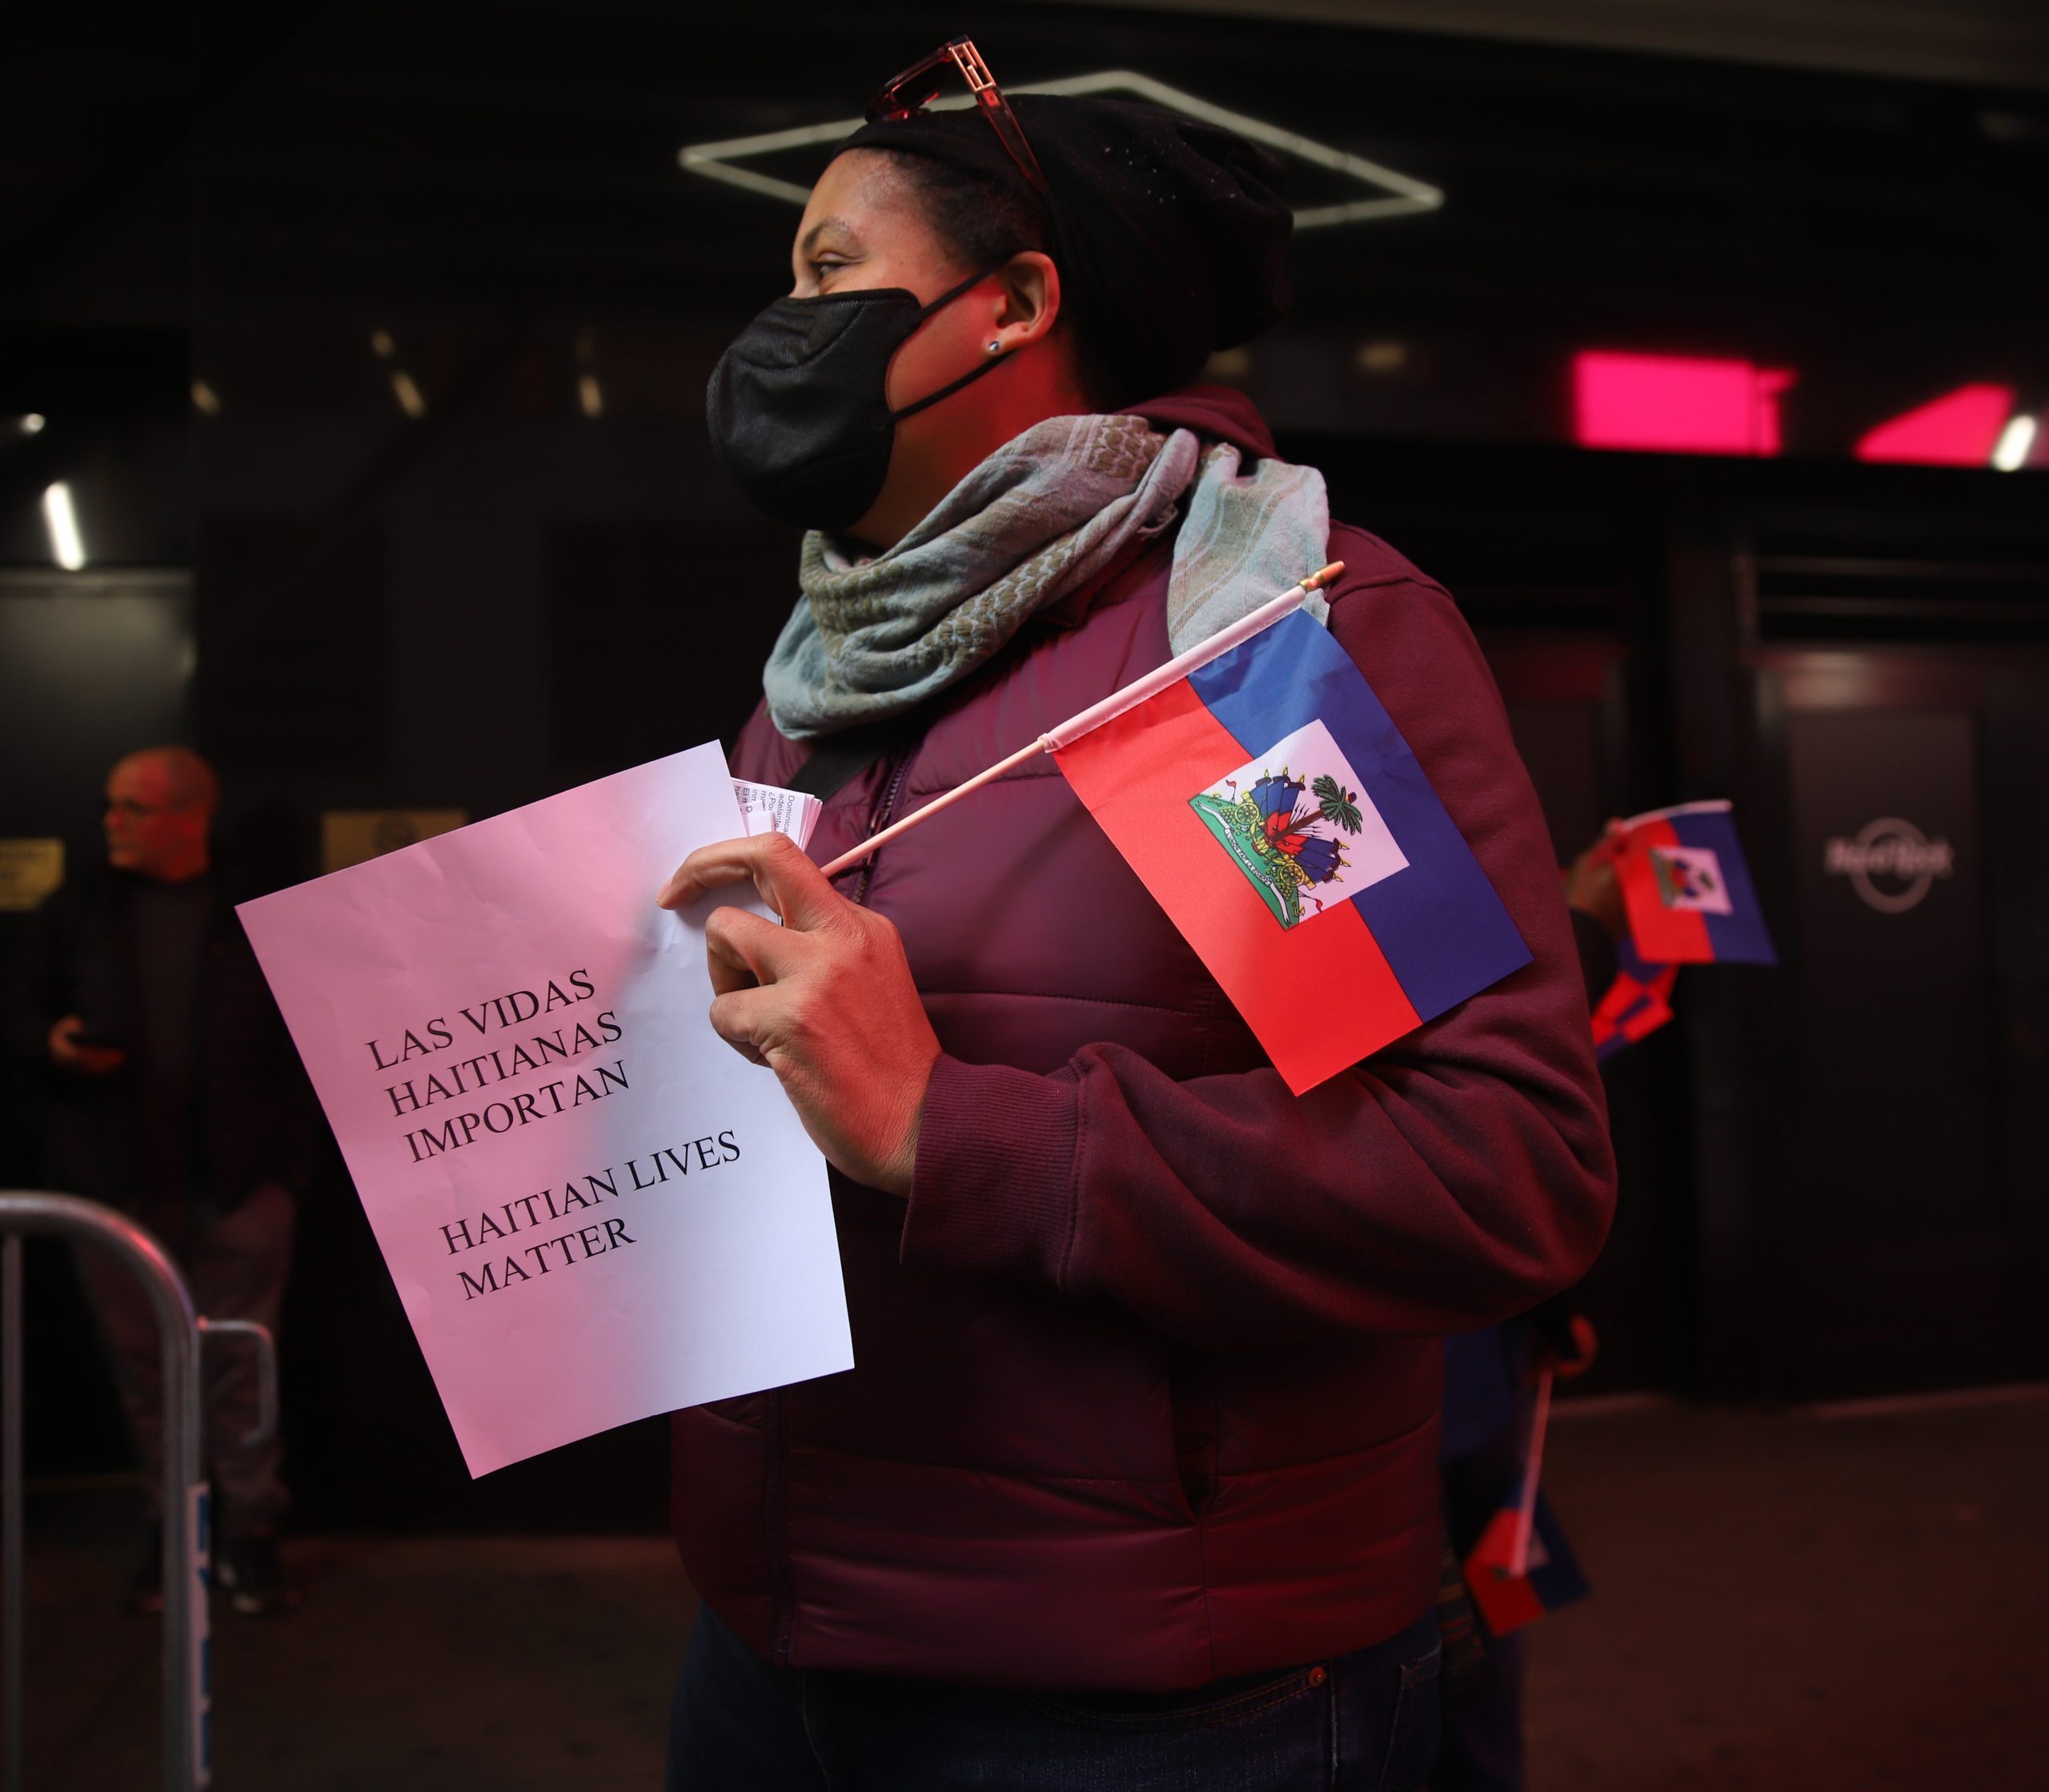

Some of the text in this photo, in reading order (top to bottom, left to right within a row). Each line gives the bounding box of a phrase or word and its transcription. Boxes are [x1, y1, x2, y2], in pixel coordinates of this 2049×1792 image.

[774, 793, 785, 832] adelante.
[366, 968, 595, 1071] LAS VIDAS
[384, 1010, 623, 1116] HAITIANAS
[403, 1060, 629, 1163] IMPORTAN
[439, 1129, 741, 1255] HAITIAN LIVES
[456, 1218, 637, 1301] MATTER
